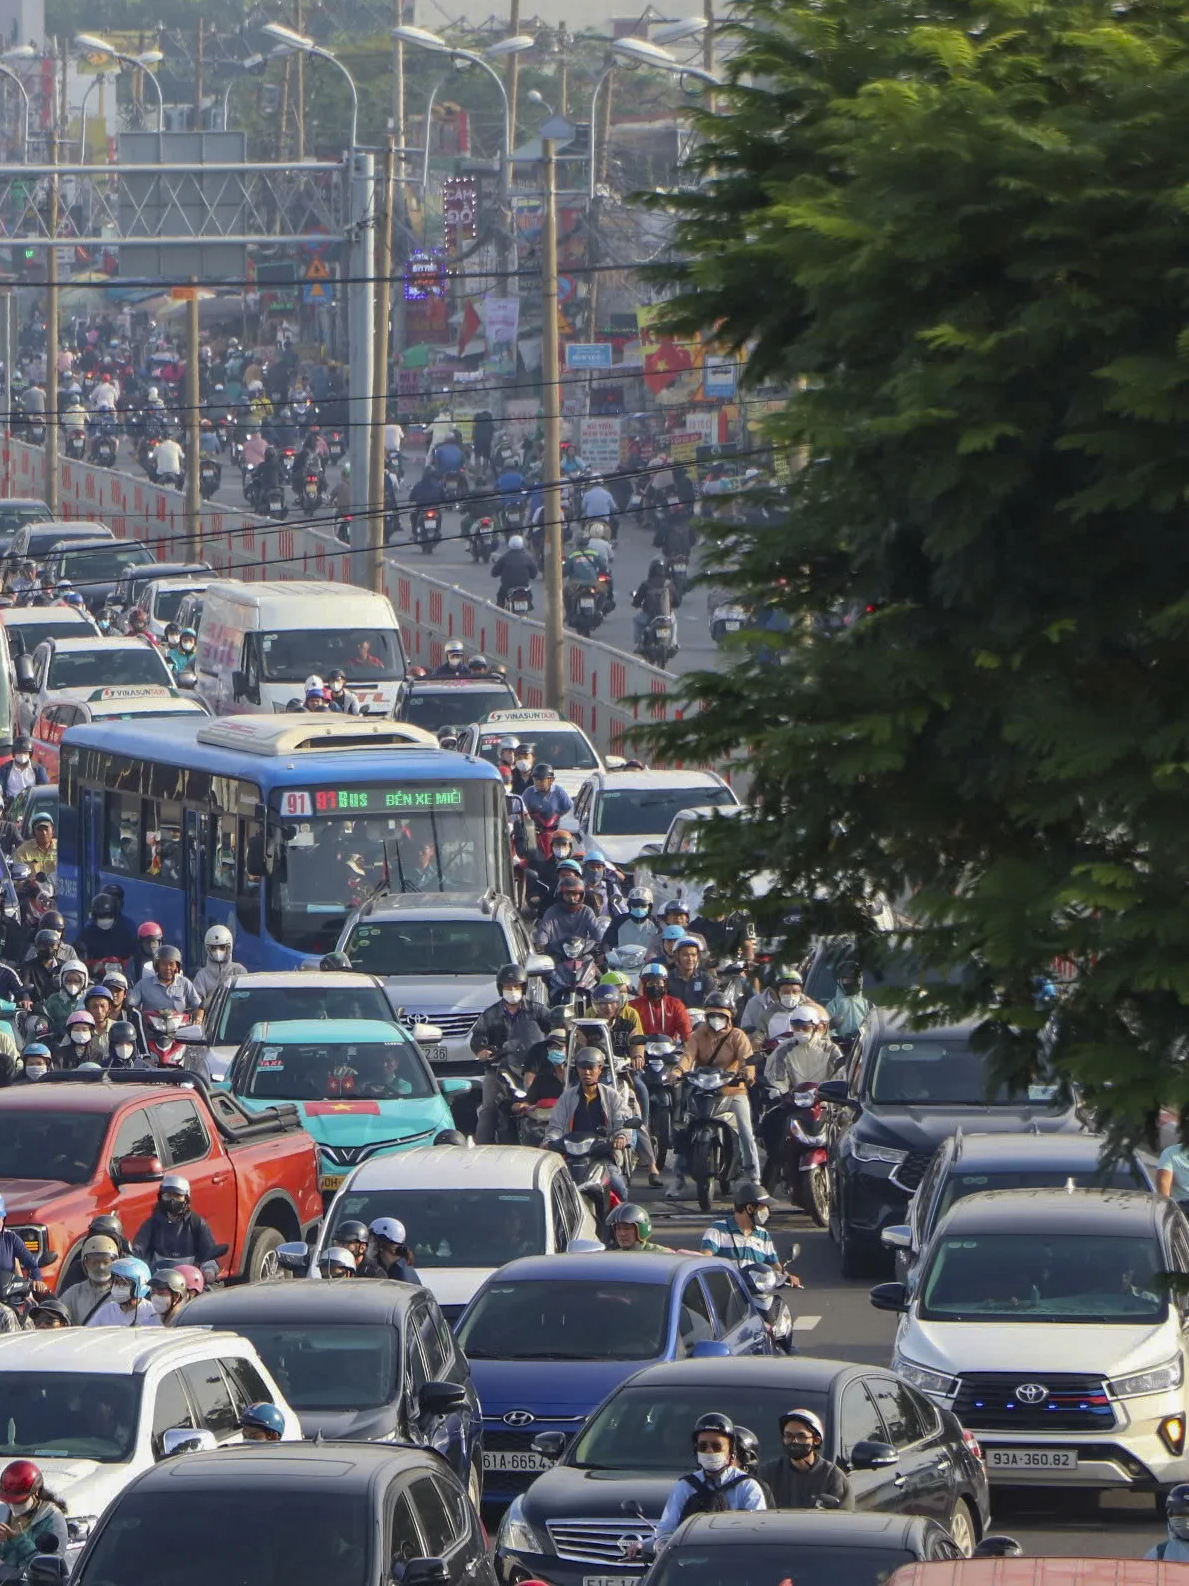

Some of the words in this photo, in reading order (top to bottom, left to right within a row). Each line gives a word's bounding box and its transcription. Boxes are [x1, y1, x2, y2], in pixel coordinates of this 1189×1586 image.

[287, 793, 306, 815] 91
[316, 791, 337, 810] 91
[338, 791, 368, 808] Bus
[385, 790, 413, 807] BẾN
[415, 792, 433, 806] XE
[993, 1453, 1070, 1466] 93A-360.82
